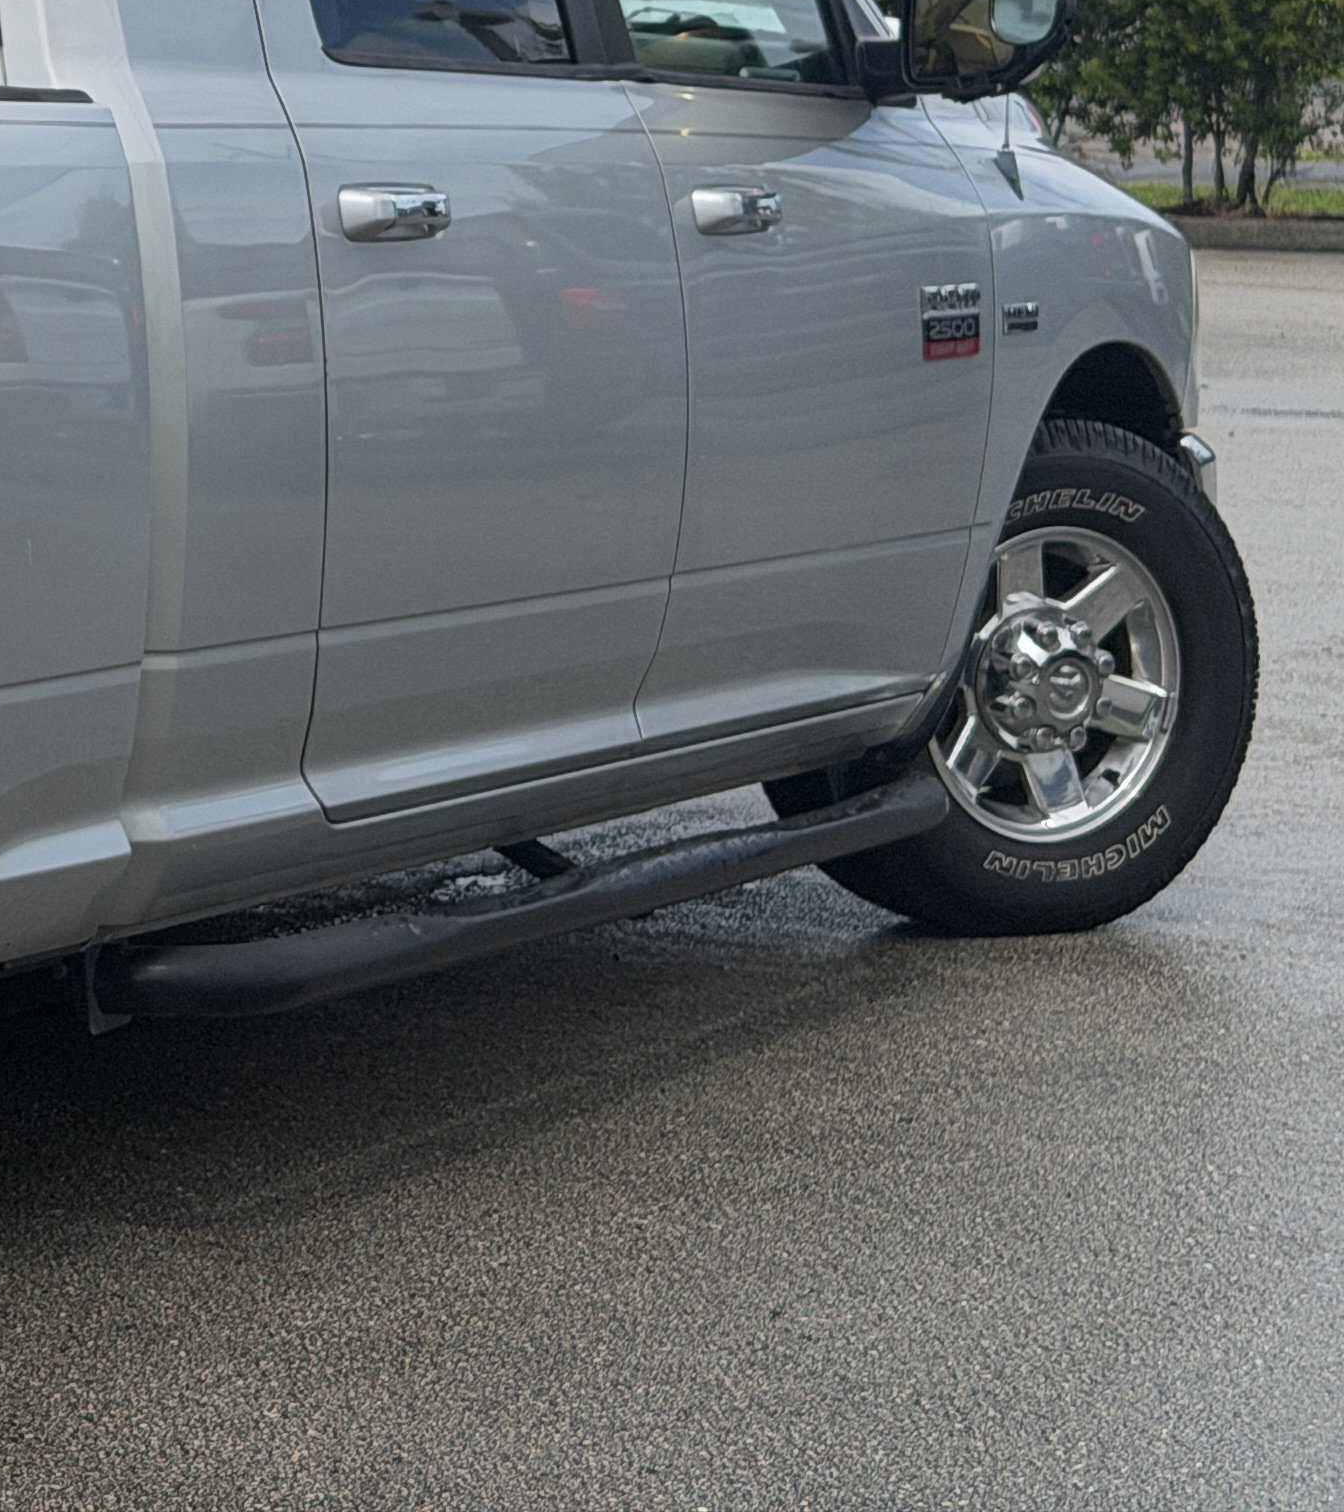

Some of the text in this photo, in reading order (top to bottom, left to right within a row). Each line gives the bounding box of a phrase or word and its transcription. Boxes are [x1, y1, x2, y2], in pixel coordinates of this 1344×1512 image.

[929, 317, 975, 340] 2500
[1004, 488, 1146, 524] CHELIN
[983, 805, 1171, 882] MICHELIN
